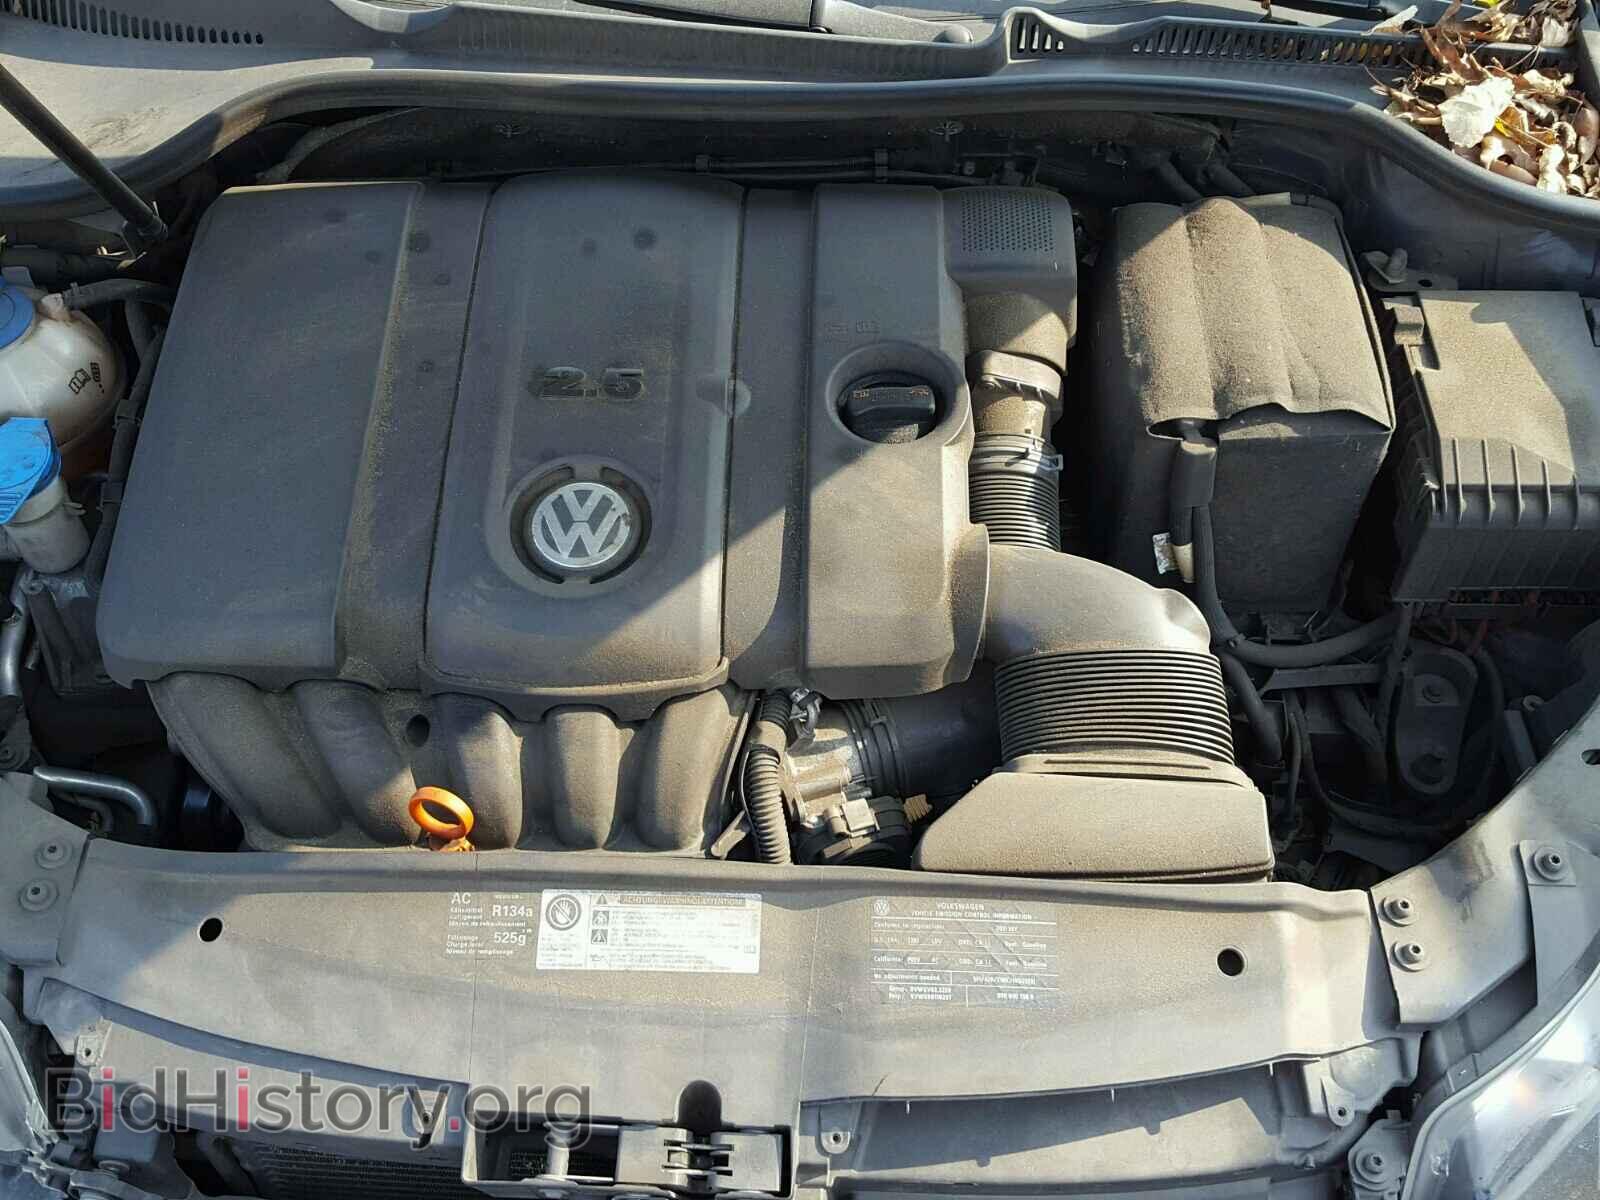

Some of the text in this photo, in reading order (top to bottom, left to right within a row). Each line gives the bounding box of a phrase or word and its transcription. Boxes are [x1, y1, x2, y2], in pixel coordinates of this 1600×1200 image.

[540, 366, 644, 401] 2.5
[451, 892, 471, 905] AC
[492, 904, 533, 917] R134a
[937, 903, 985, 911] VOLKSWAGEN
[494, 931, 526, 946] 525g
